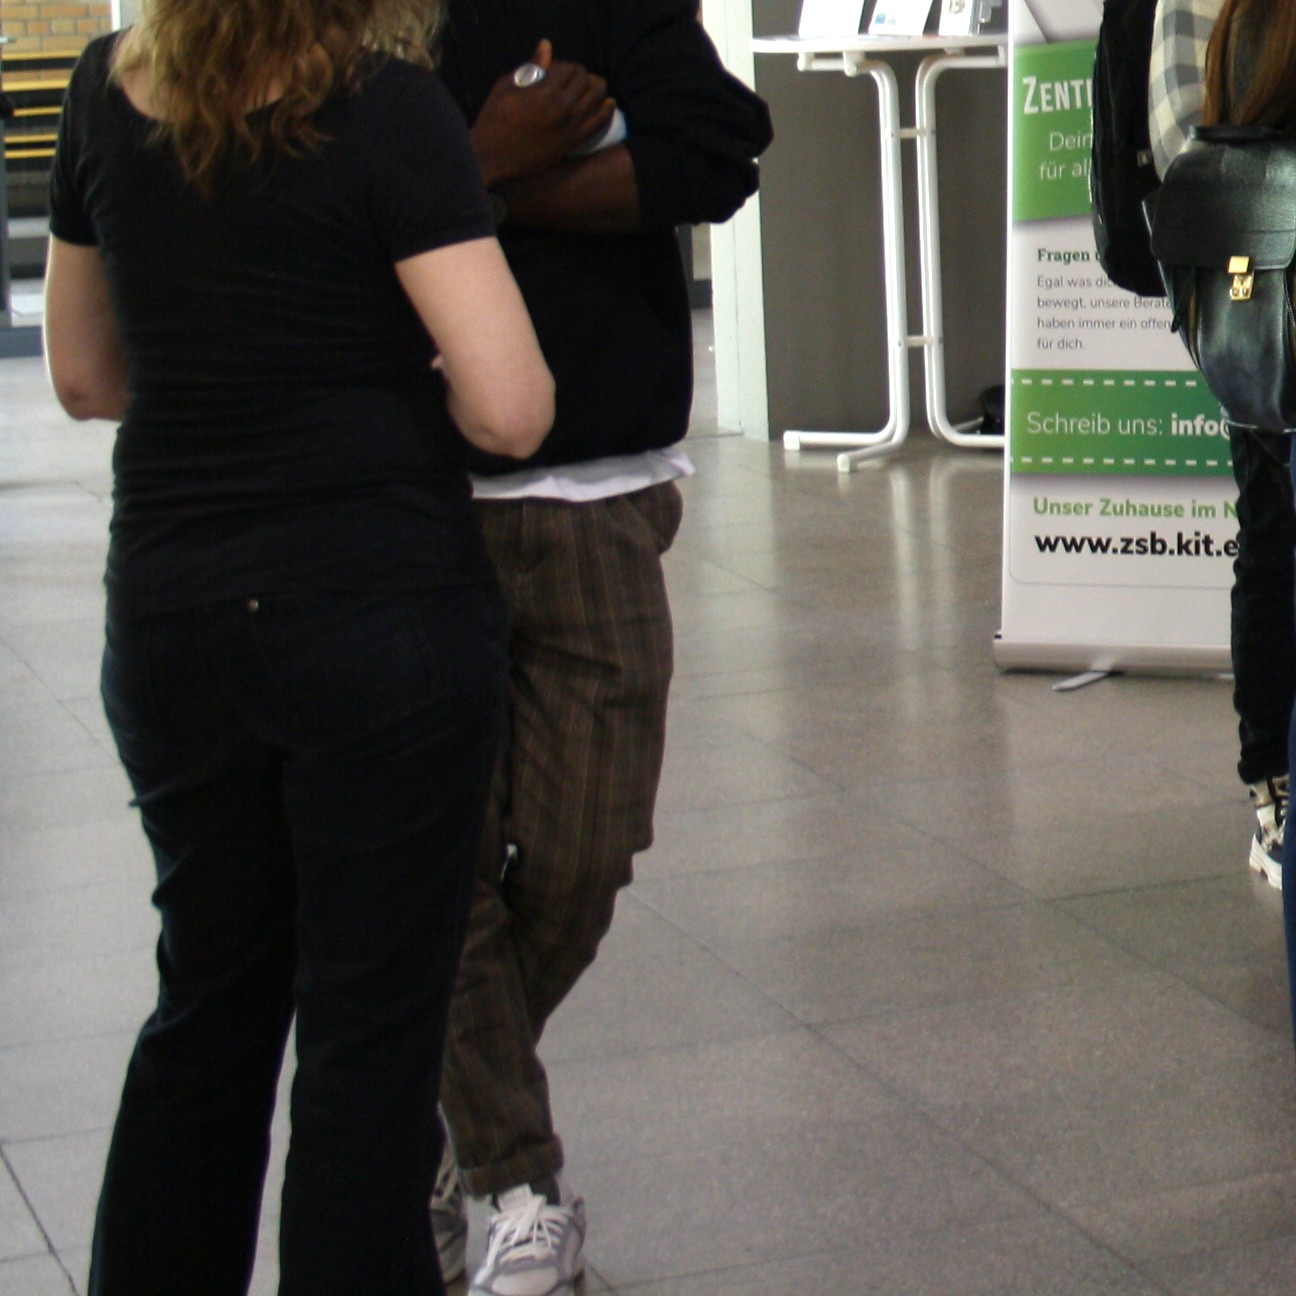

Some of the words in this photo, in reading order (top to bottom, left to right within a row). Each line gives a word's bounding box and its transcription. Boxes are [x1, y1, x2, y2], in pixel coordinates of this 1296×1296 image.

[1039, 160, 1067, 180] für
[1036, 247, 1091, 266] Fragen
[1037, 275, 1064, 290] Egal
[1067, 278, 1093, 288] was
[1096, 275, 1117, 288] dic
[1089, 299, 1131, 309] unsere
[1037, 317, 1075, 329] haben
[1078, 318, 1117, 329] immer
[1119, 318, 1138, 329] ein
[1140, 317, 1172, 329] offen
[1037, 337, 1054, 350] für
[1027, 410, 1111, 435] Schreib
[1118, 415, 1164, 435] uns:
[1033, 496, 1093, 516] Unser
[1099, 497, 1185, 518] Zuhause
[1191, 499, 1217, 518] im
[1223, 500, 1239, 519] N
[1035, 530, 1240, 557] www.zsb.kit.e
